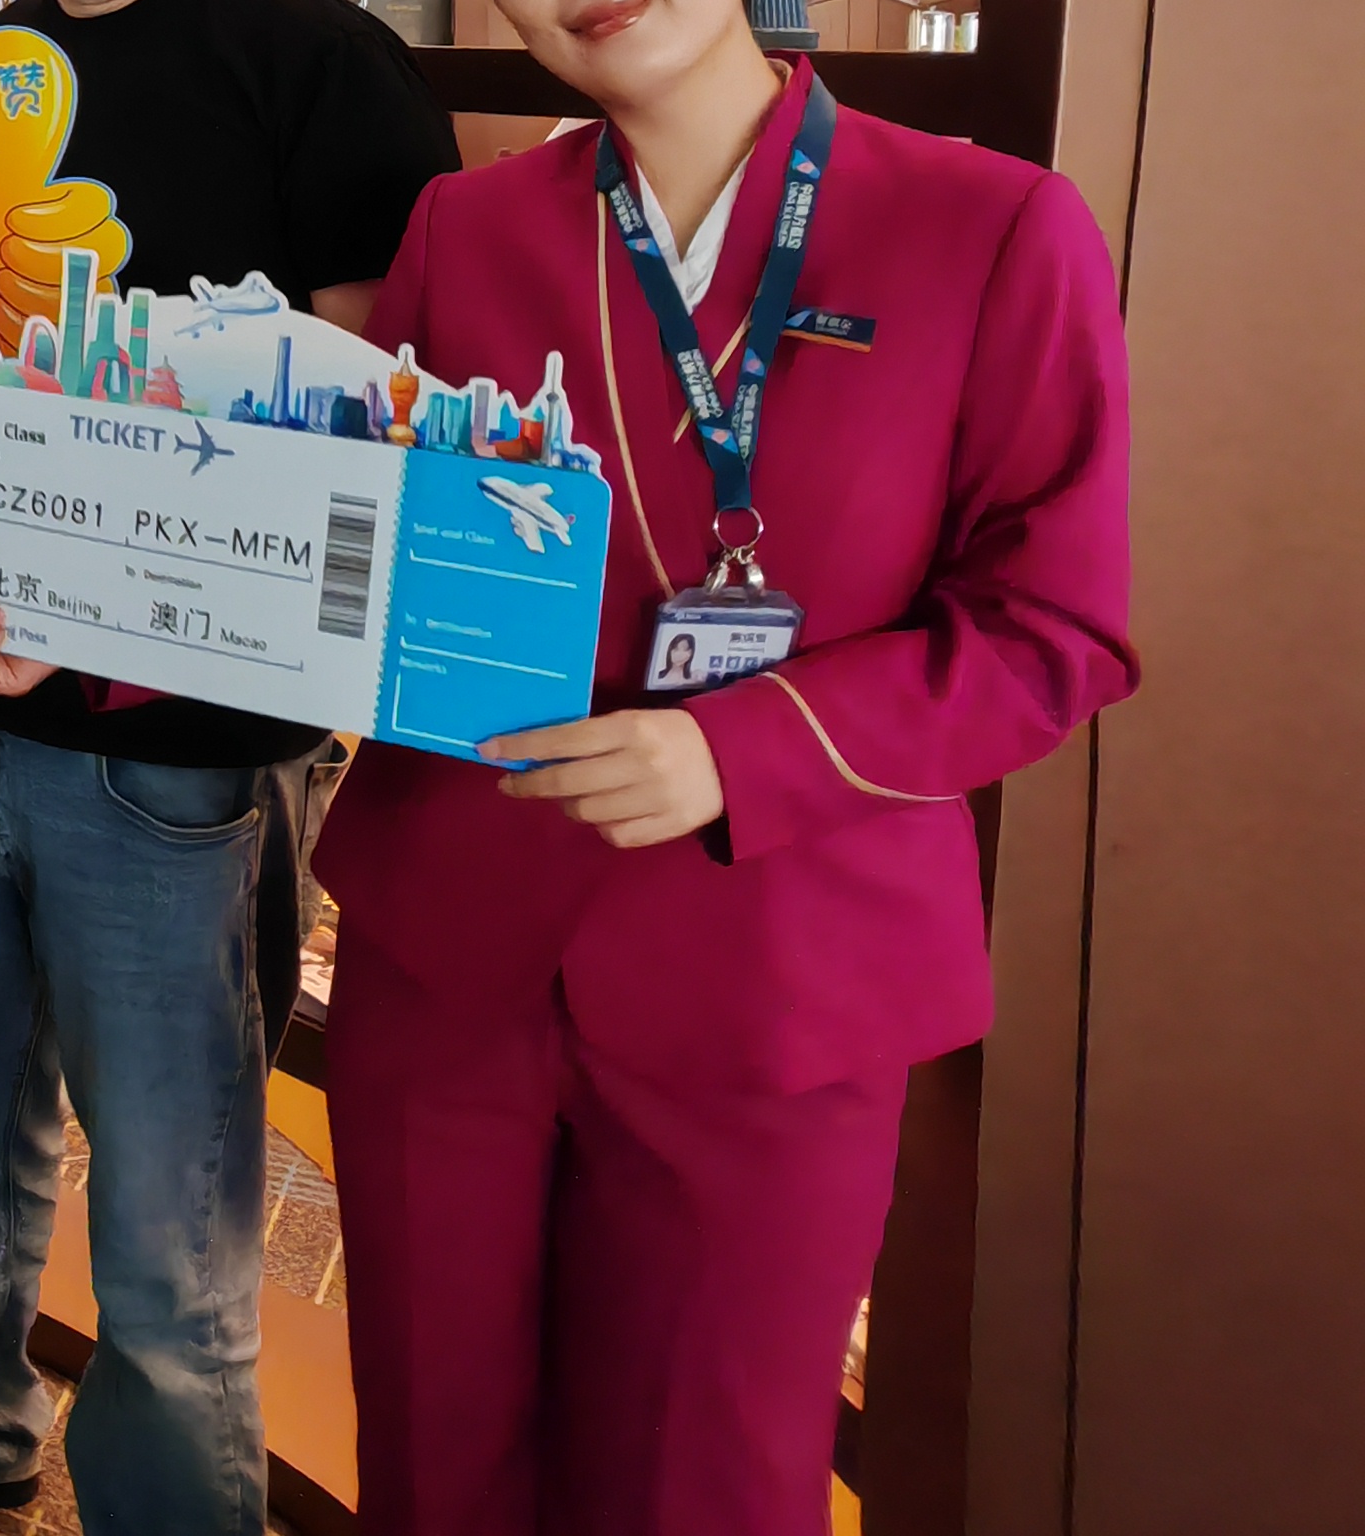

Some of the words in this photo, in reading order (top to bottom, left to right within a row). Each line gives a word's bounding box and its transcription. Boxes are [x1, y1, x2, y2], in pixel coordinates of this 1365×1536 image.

[3, 422, 47, 446] Class
[69, 414, 167, 453] TICKET
[133, 509, 312, 569] PKX-MFM
[47, 590, 102, 621] Beijing
[149, 600, 211, 641] 澳门
[219, 627, 268, 652] Macao
